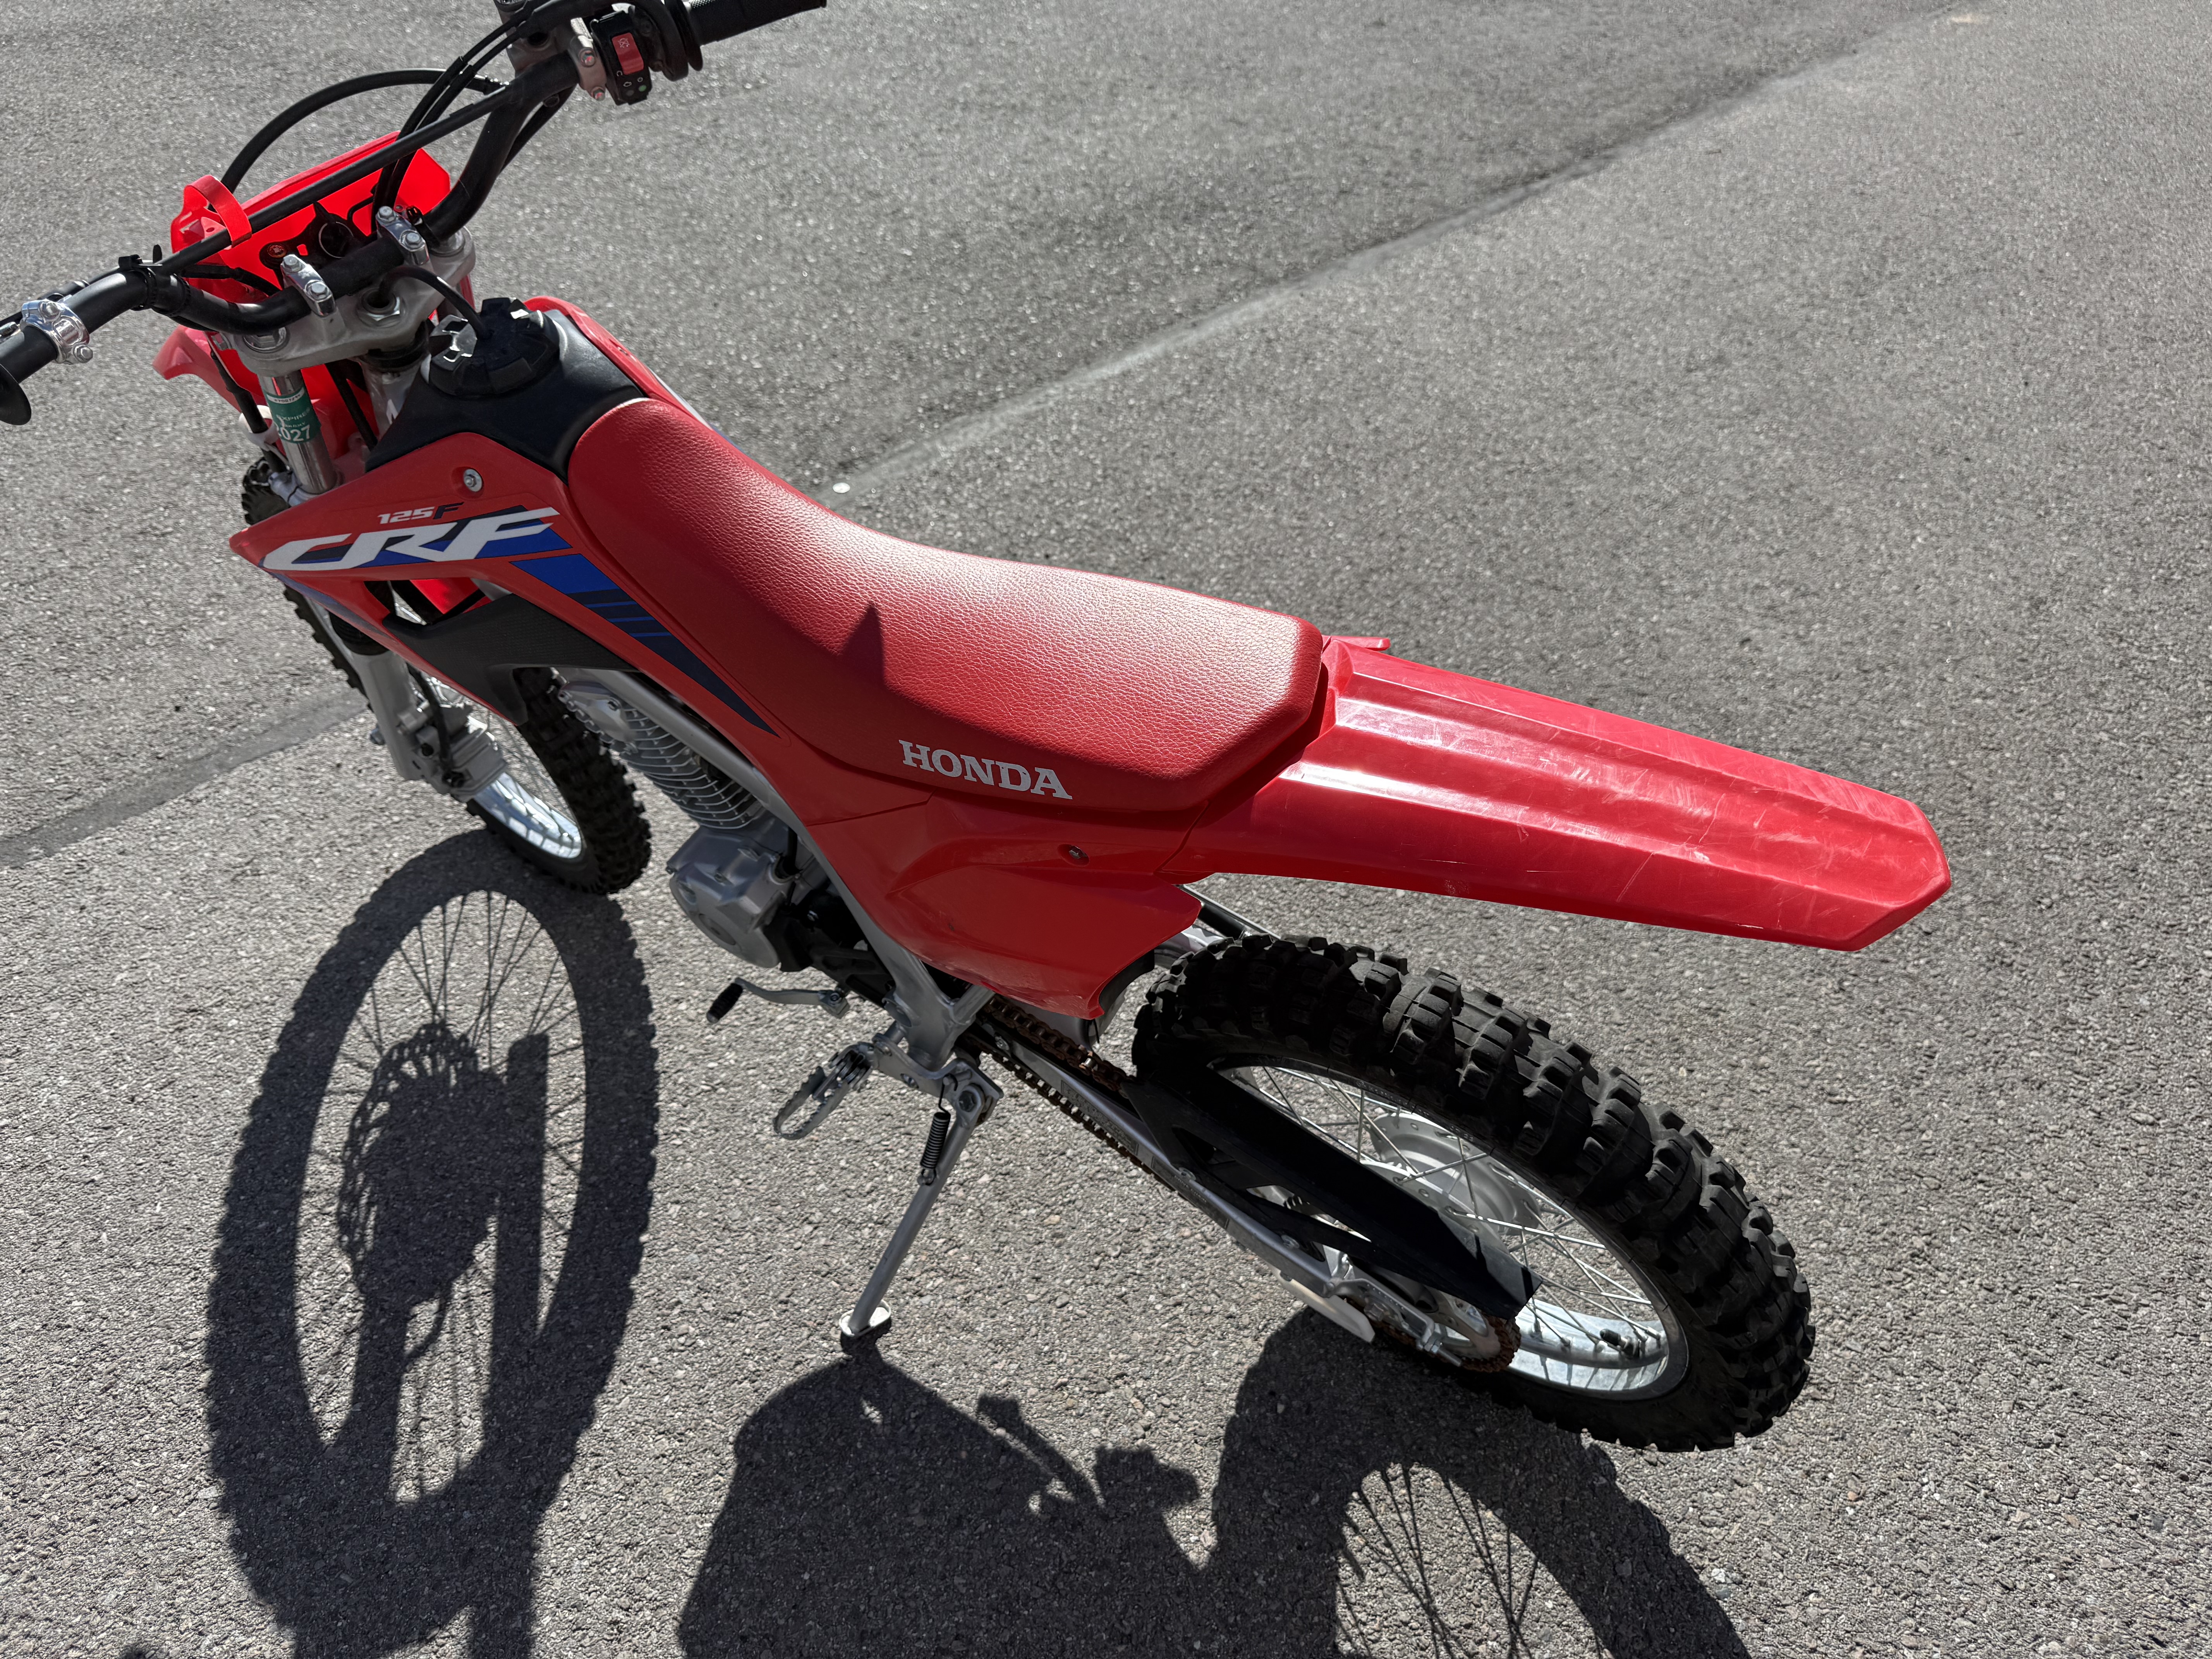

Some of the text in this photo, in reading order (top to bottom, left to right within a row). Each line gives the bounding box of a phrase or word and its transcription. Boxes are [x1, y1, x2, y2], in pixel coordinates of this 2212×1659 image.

[263, 507, 560, 571] CRF
[378, 501, 464, 524] 125F
[898, 739, 1073, 800] HONDA
